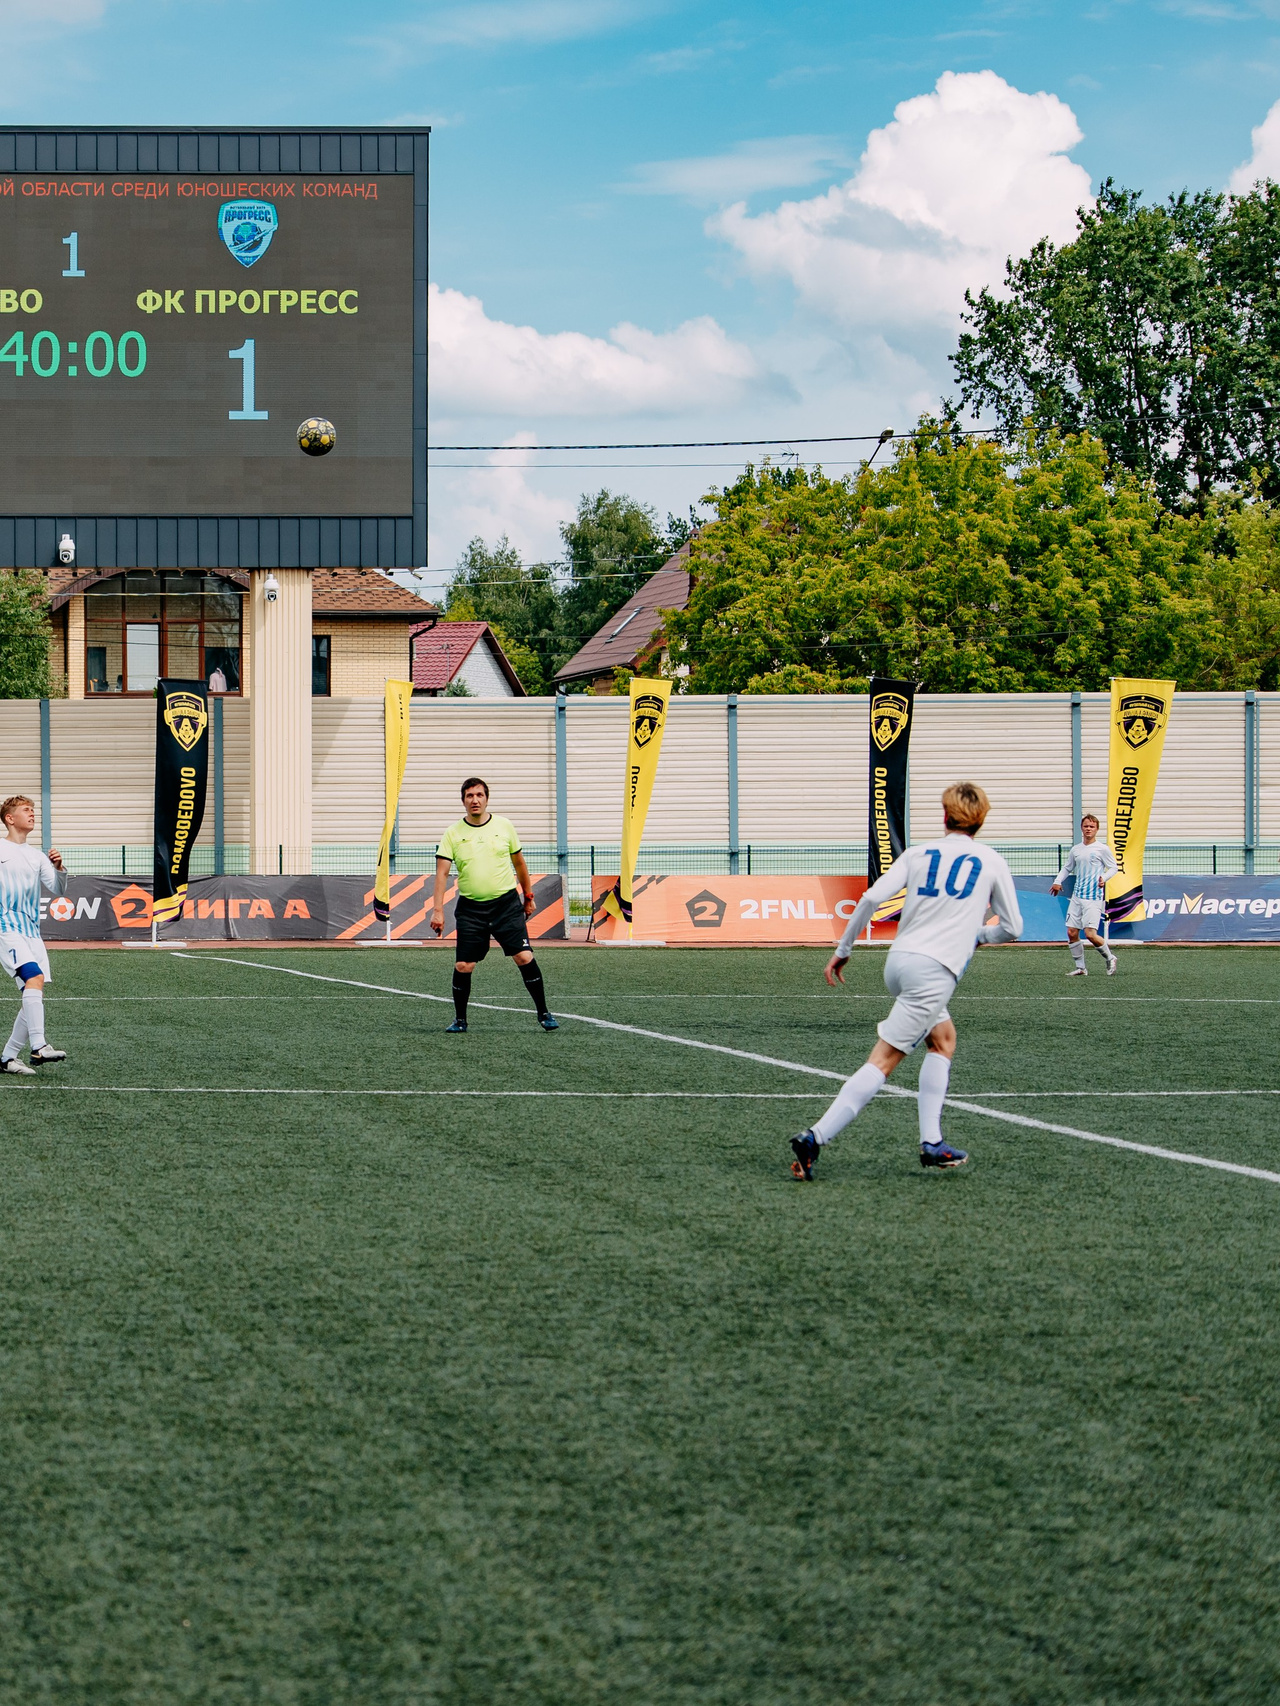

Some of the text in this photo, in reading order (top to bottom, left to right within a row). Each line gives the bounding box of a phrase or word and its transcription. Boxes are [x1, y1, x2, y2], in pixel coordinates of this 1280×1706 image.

[21, 181, 105, 197] ОБЛАСТИ
[111, 181, 169, 200] СРЕДИ
[177, 182, 296, 198] ЮНОШЕСКИХ
[303, 182, 378, 200] КОМАНД
[62, 231, 86, 277] 1
[136, 289, 359, 314] ФК ПРОГРЕСС
[228, 339, 269, 421] 1
[874, 766, 894, 875] DOMODEDOVO
[916, 848, 983, 900] 10
[283, 899, 311, 919] А
[8, 948, 18, 965] 7
